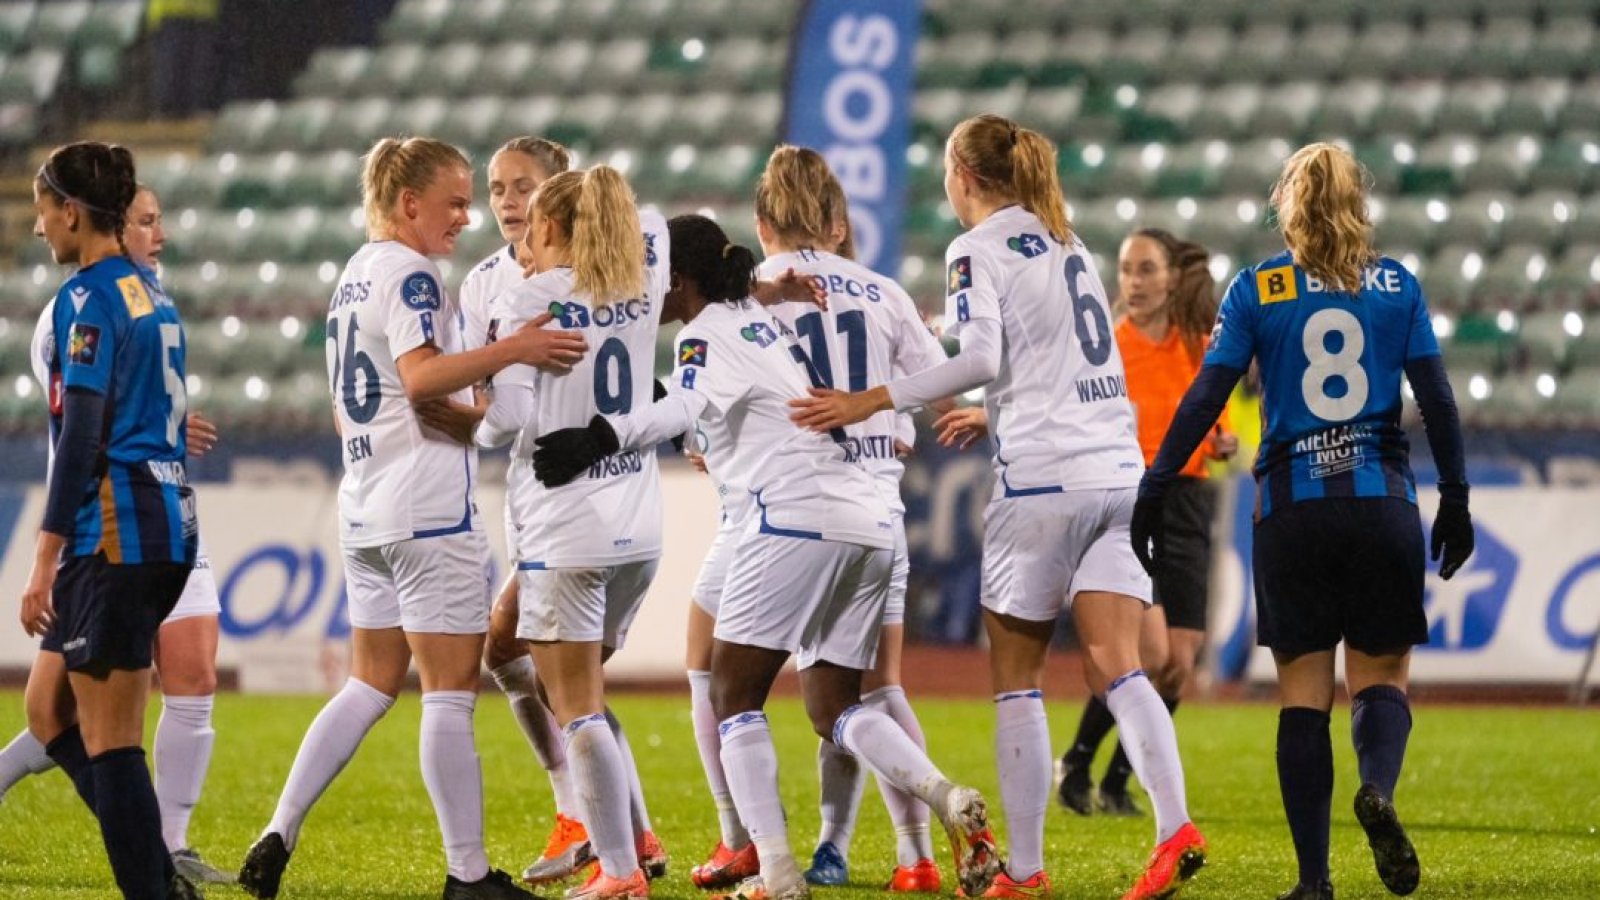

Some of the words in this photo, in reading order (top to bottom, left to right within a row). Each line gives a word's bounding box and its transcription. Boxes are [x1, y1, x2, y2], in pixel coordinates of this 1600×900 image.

[1064, 254, 1112, 367] 6
[1267, 273, 1287, 297] B
[1305, 267, 1401, 293] BAKE
[159, 323, 188, 449] 5
[593, 336, 634, 417] 9
[1301, 307, 1370, 422] 8
